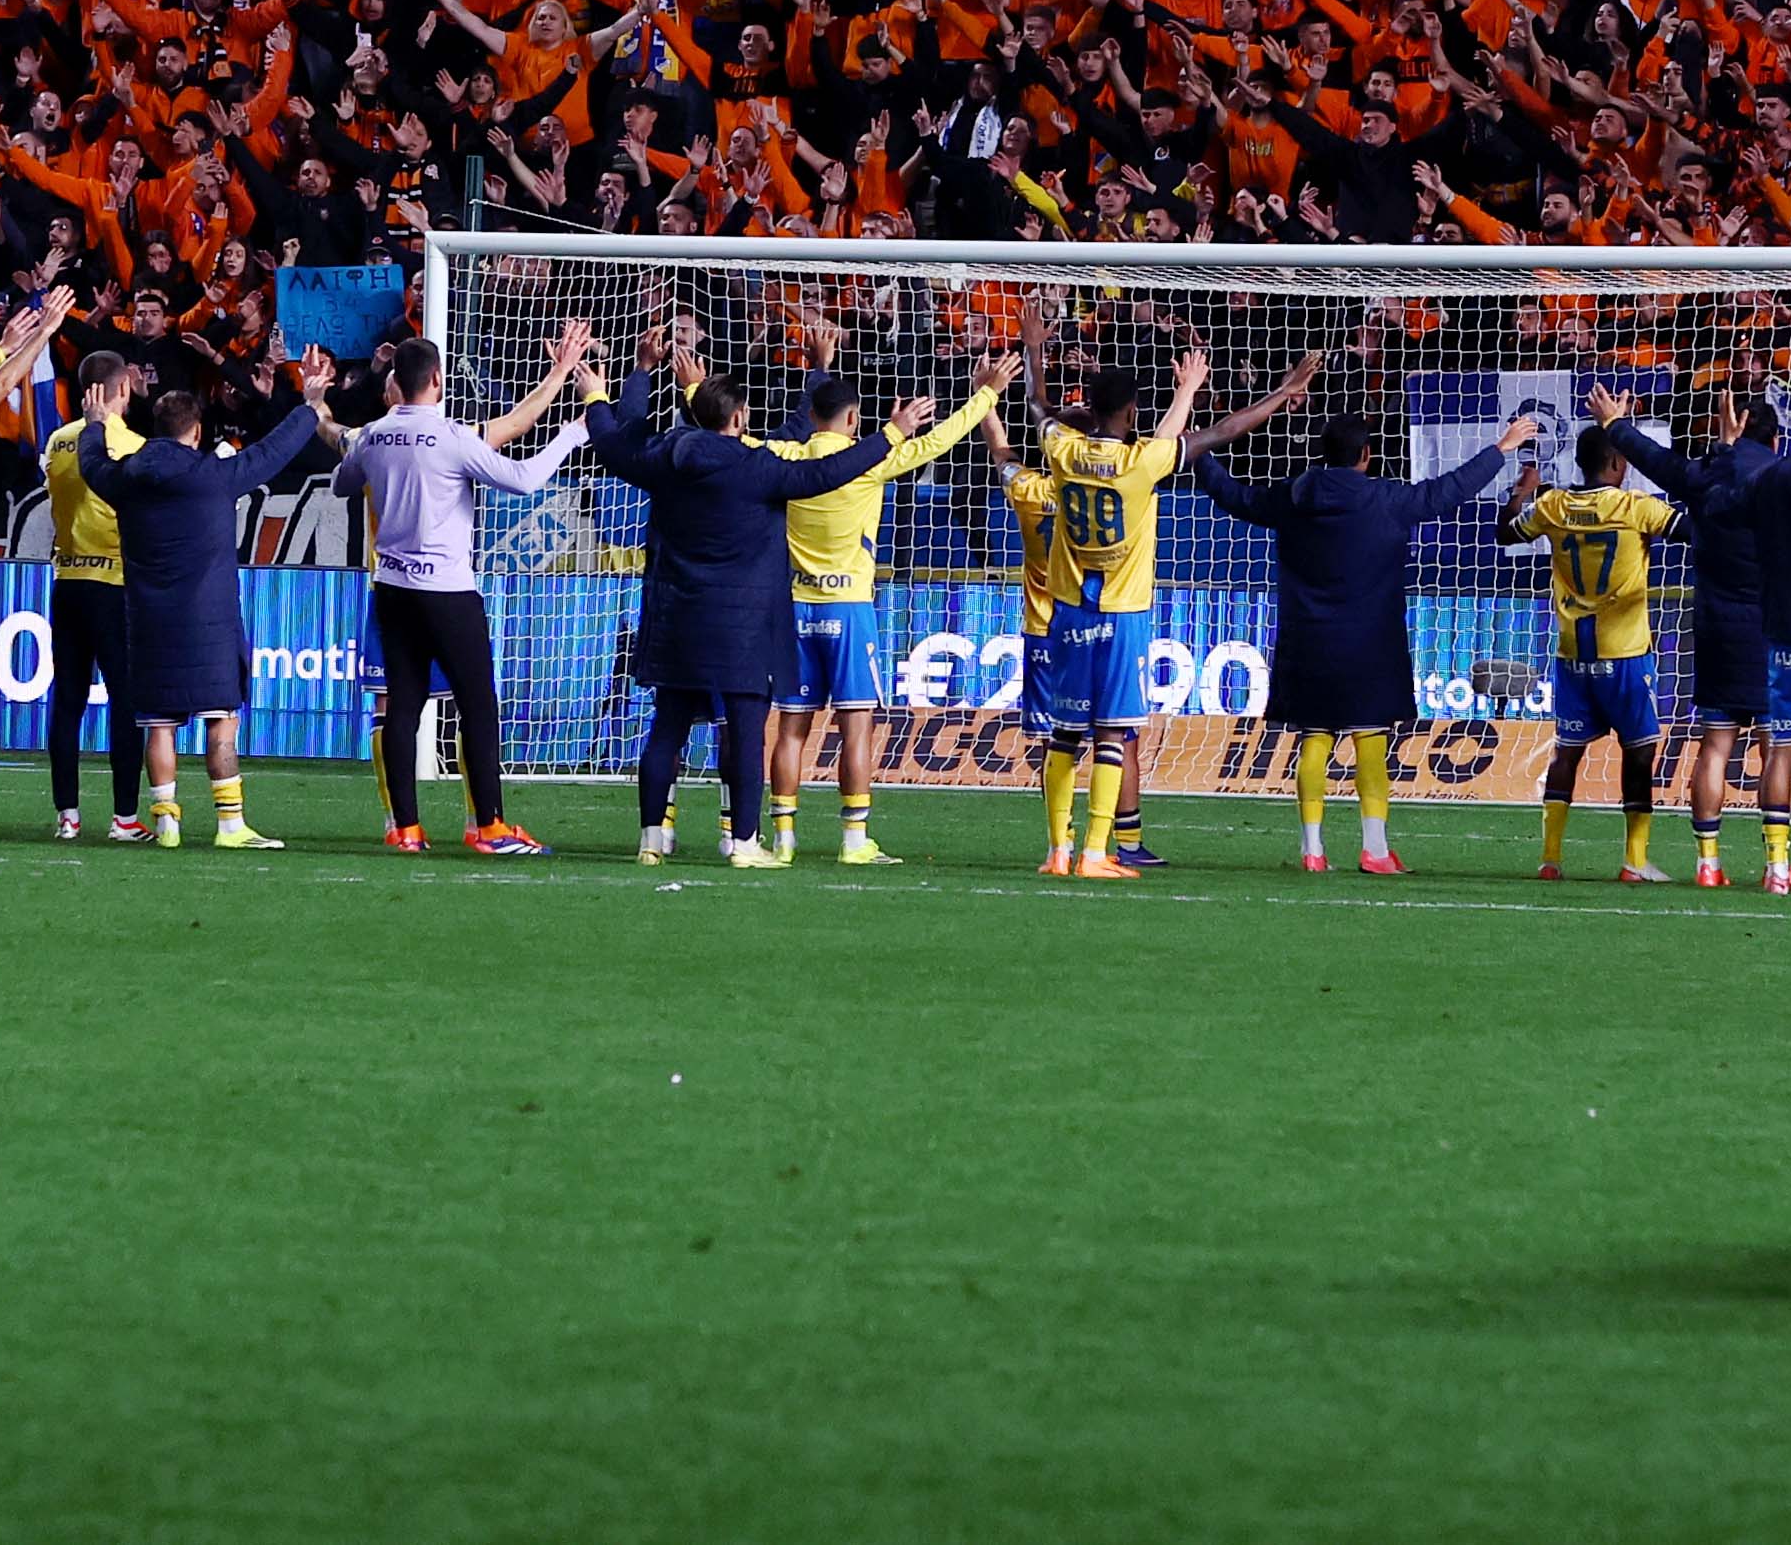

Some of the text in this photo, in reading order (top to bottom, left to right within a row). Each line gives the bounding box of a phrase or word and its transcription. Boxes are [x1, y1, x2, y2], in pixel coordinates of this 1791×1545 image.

[368, 433, 437, 447] APOEL FC
[1063, 483, 1125, 547] 99
[1563, 530, 1618, 596] 17
